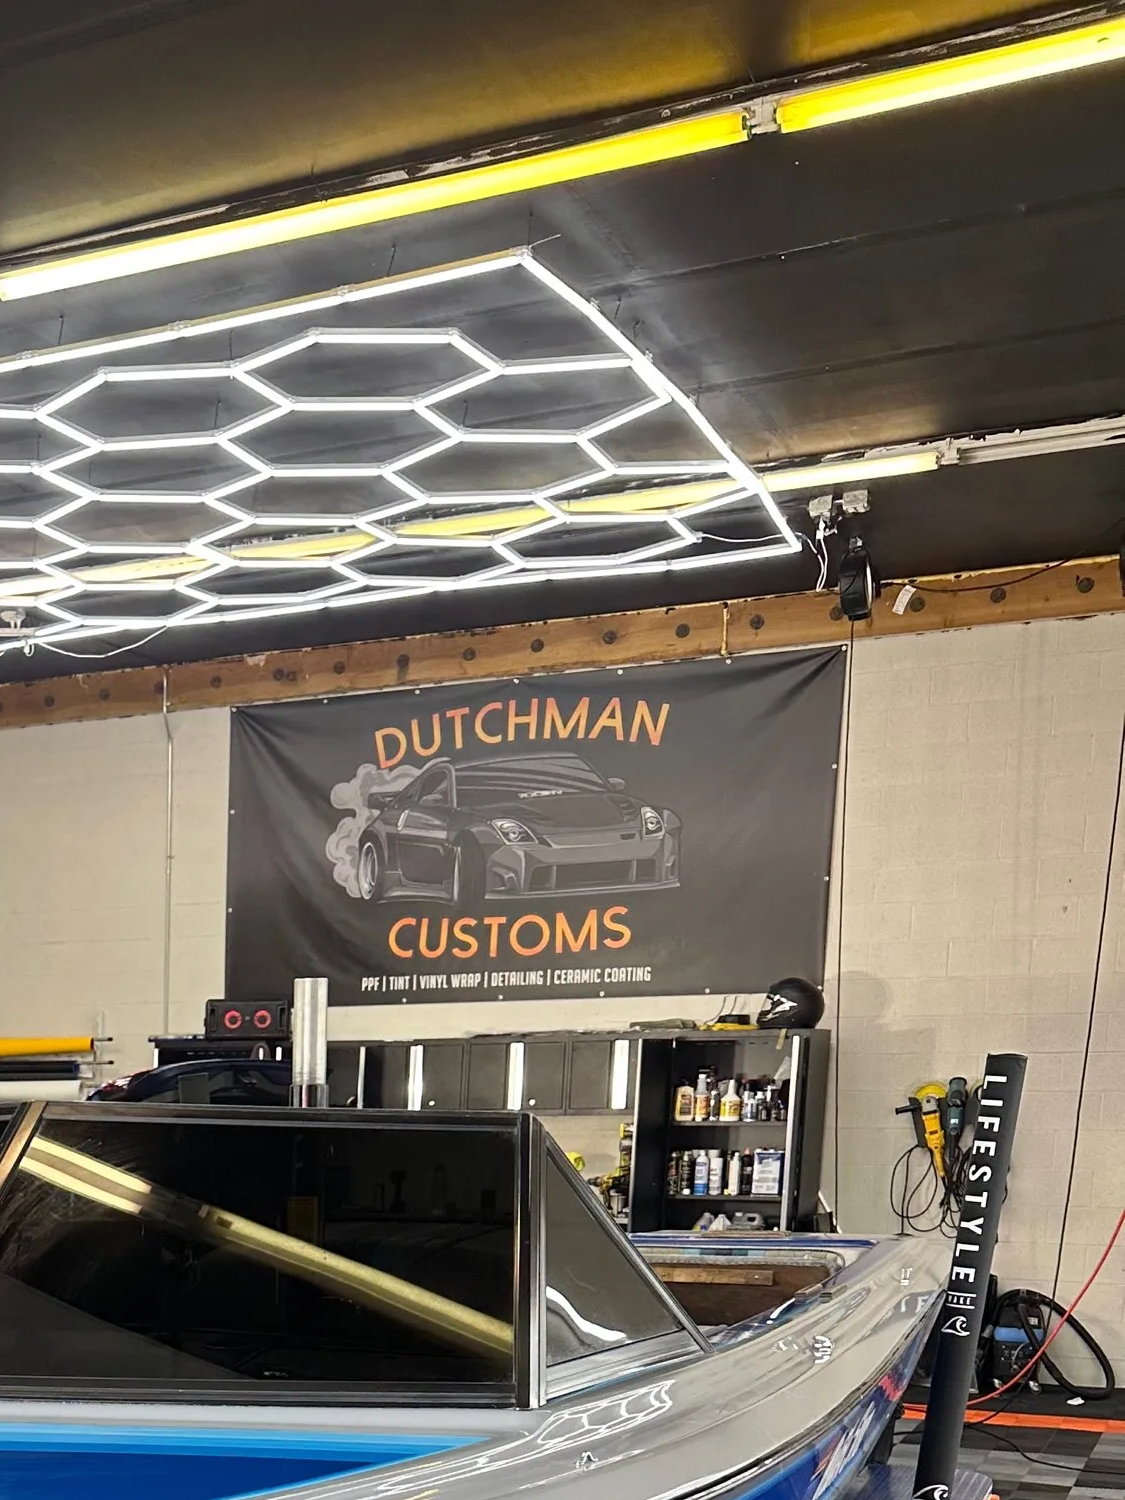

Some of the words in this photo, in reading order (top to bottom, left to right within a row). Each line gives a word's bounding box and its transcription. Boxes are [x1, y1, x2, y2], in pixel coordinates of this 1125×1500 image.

[374, 696, 671, 769] DUTCHMAN
[387, 906, 632, 959] CUSTOMS
[361, 977, 381, 991] PPF
[389, 975, 411, 991] TINT
[419, 974, 449, 990] VINYL
[451, 973, 482, 989] WRAP
[491, 970, 544, 987] DETAILING
[553, 968, 602, 985] CERAMIC
[604, 966, 652, 983] COATING
[951, 1074, 1008, 1283] LIFESTYLE
